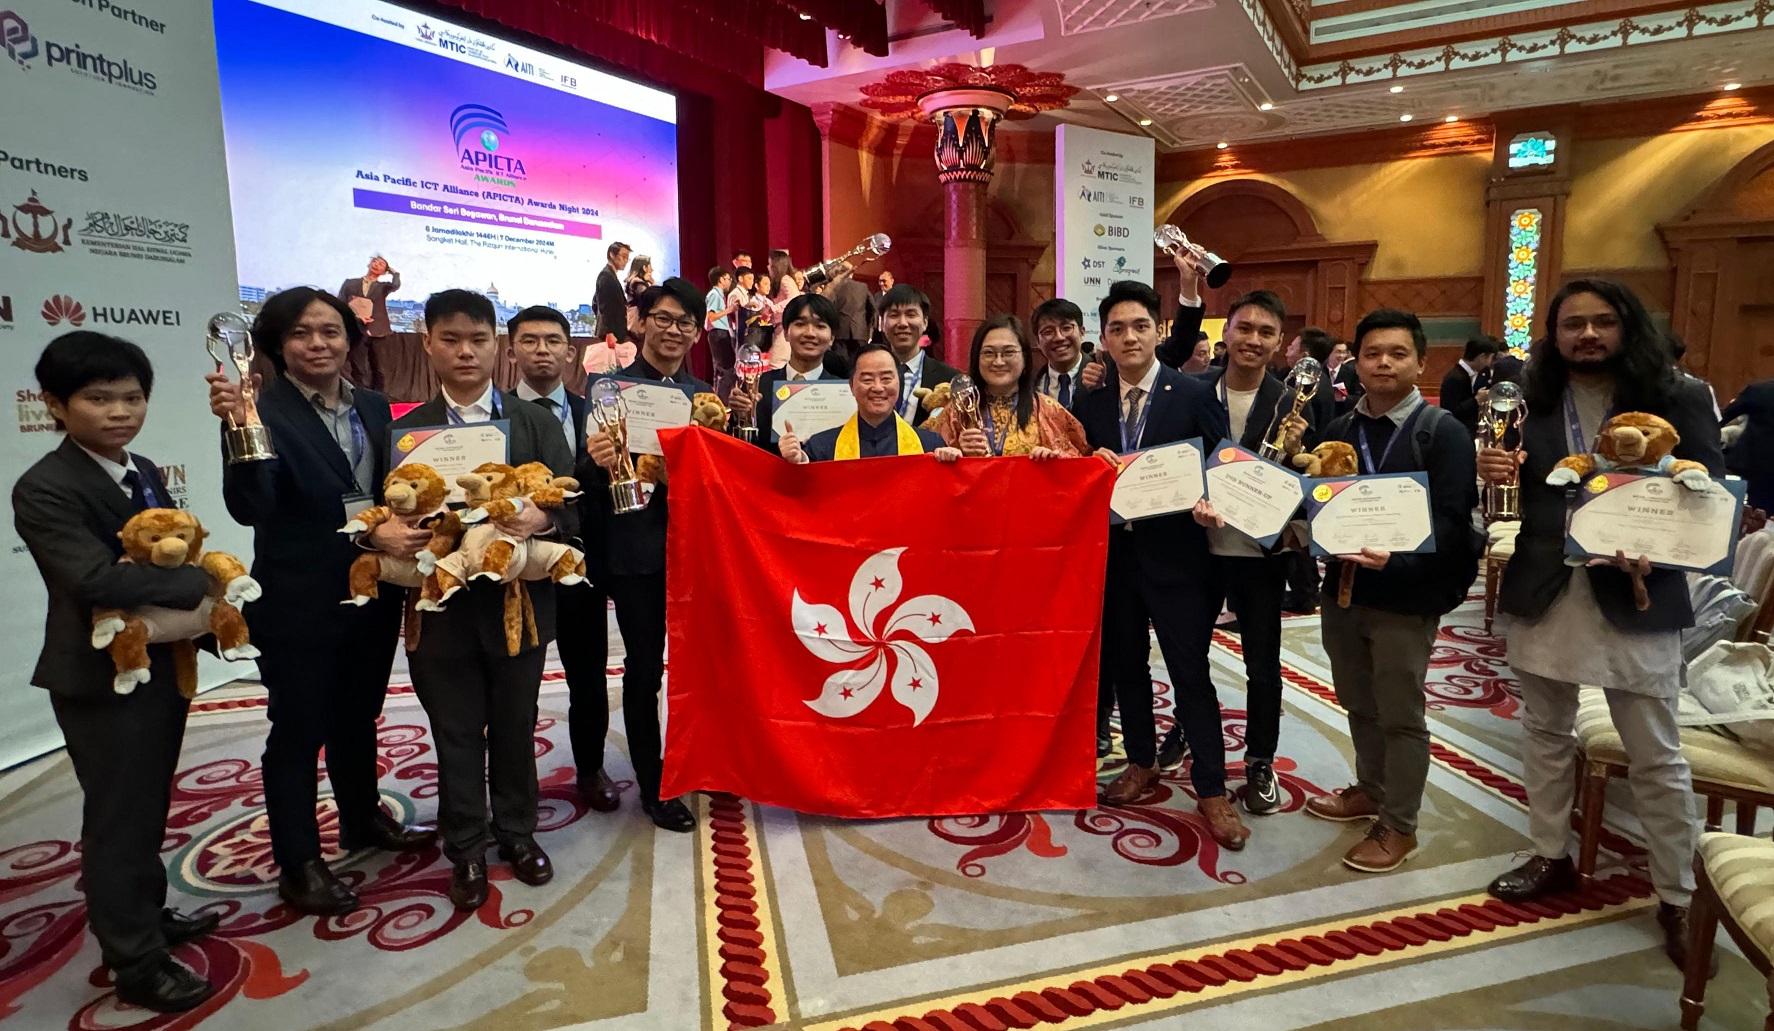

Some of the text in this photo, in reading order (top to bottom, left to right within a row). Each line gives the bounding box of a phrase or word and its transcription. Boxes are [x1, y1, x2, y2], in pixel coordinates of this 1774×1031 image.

[98, 0, 166, 34] Partner
[438, 38, 466, 54] MTIC
[45, 40, 157, 90] printplus
[520, 61, 534, 76] AITI
[560, 75, 576, 87] IFB
[460, 148, 526, 175] APICTA
[474, 174, 517, 188] AWARDS
[1097, 170, 1119, 181] MTIC
[355, 169, 599, 217] Asia Pacific ICT Alliance (APICTA) Awards Night 2024
[1129, 196, 1144, 206] IFB
[410, 200, 442, 214] Bandar
[443, 205, 460, 216] Seri
[1108, 226, 1130, 238] BIBD
[504, 236, 535, 245] December
[1092, 260, 1106, 268] DST
[1084, 276, 1102, 286] UNN
[92, 306, 182, 326] HUAWEI
[1140, 471, 1168, 481] WINNER
[1627, 505, 1674, 516] WINNER
